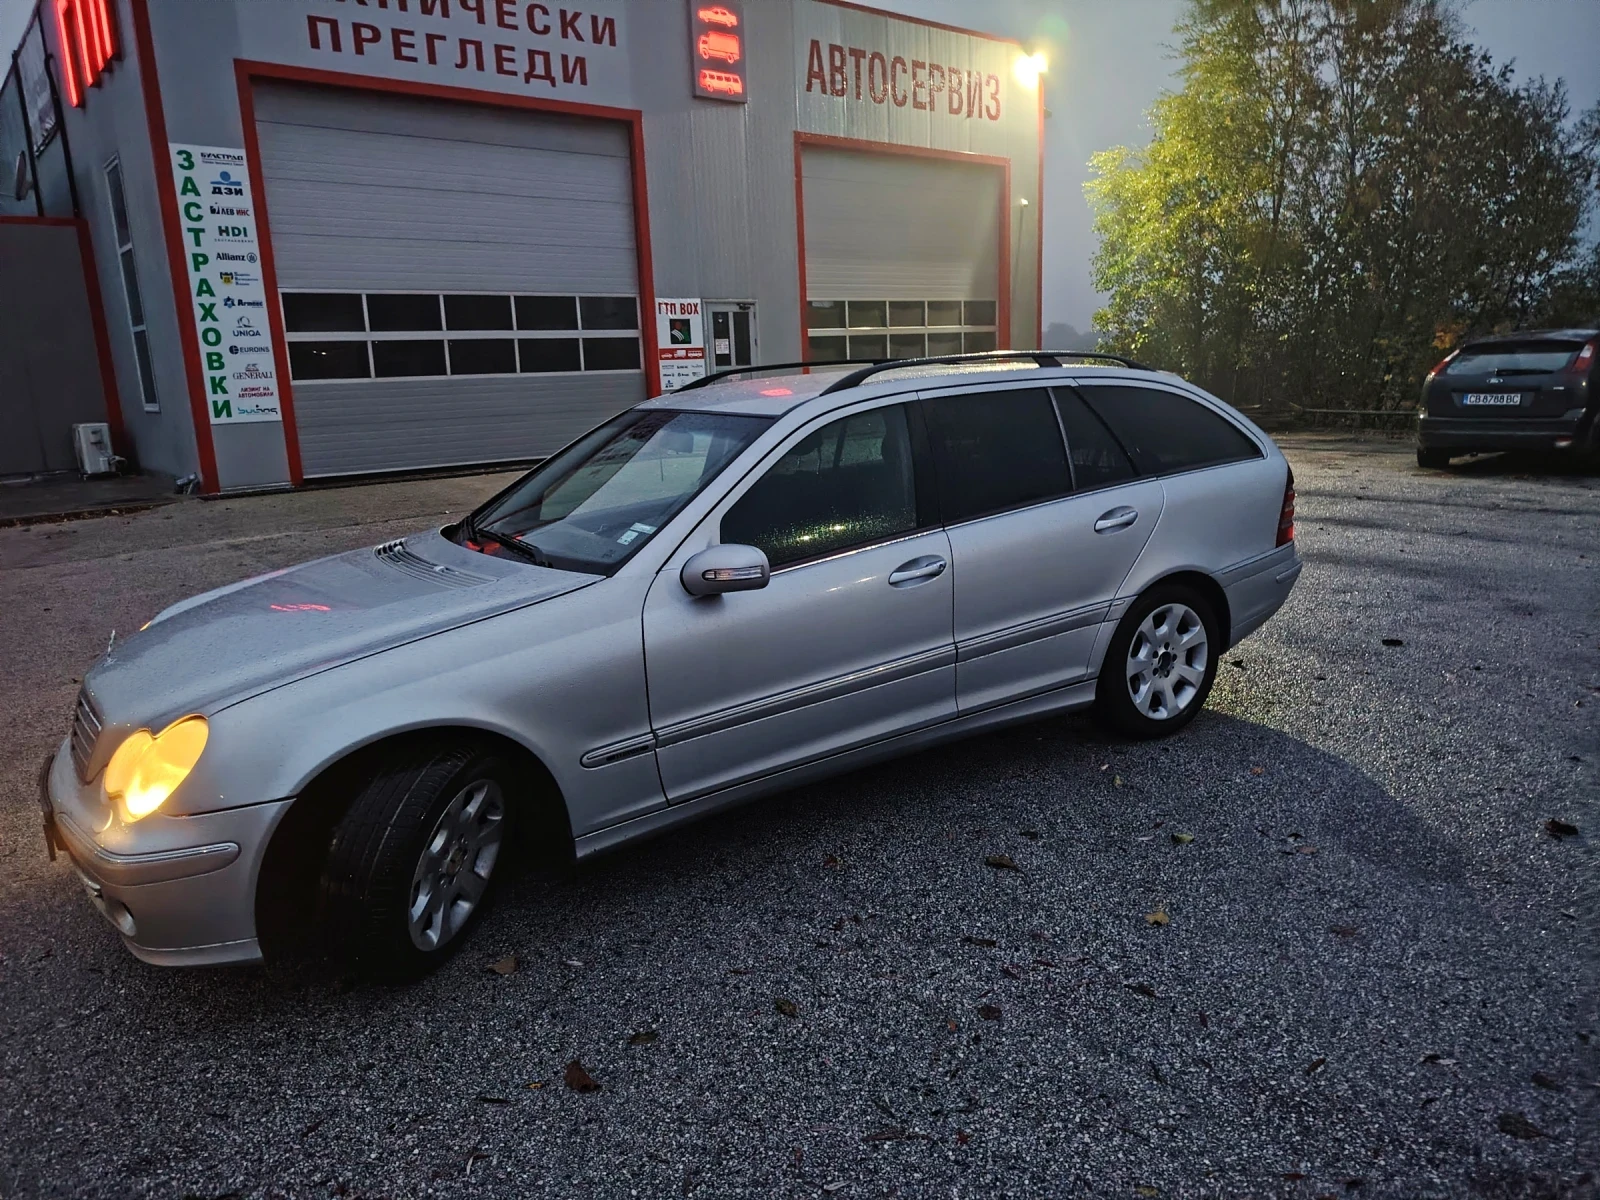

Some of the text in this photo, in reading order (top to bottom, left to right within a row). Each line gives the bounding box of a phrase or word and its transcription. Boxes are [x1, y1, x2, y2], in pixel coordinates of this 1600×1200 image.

[334, 0, 617, 47] ИЧЕСКИ
[306, 14, 588, 88] ПРЕГЛЕДИ
[805, 39, 1001, 121] АВТОСЕРВИЗ
[211, 186, 243, 196] ДЗИ
[218, 225, 248, 238] HDI
[216, 252, 246, 262] Allianz
[176, 150, 233, 419] ЗАСТРАХОВКИ
[658, 302, 677, 315] ГТП
[232, 372, 274, 380] GENERALI
